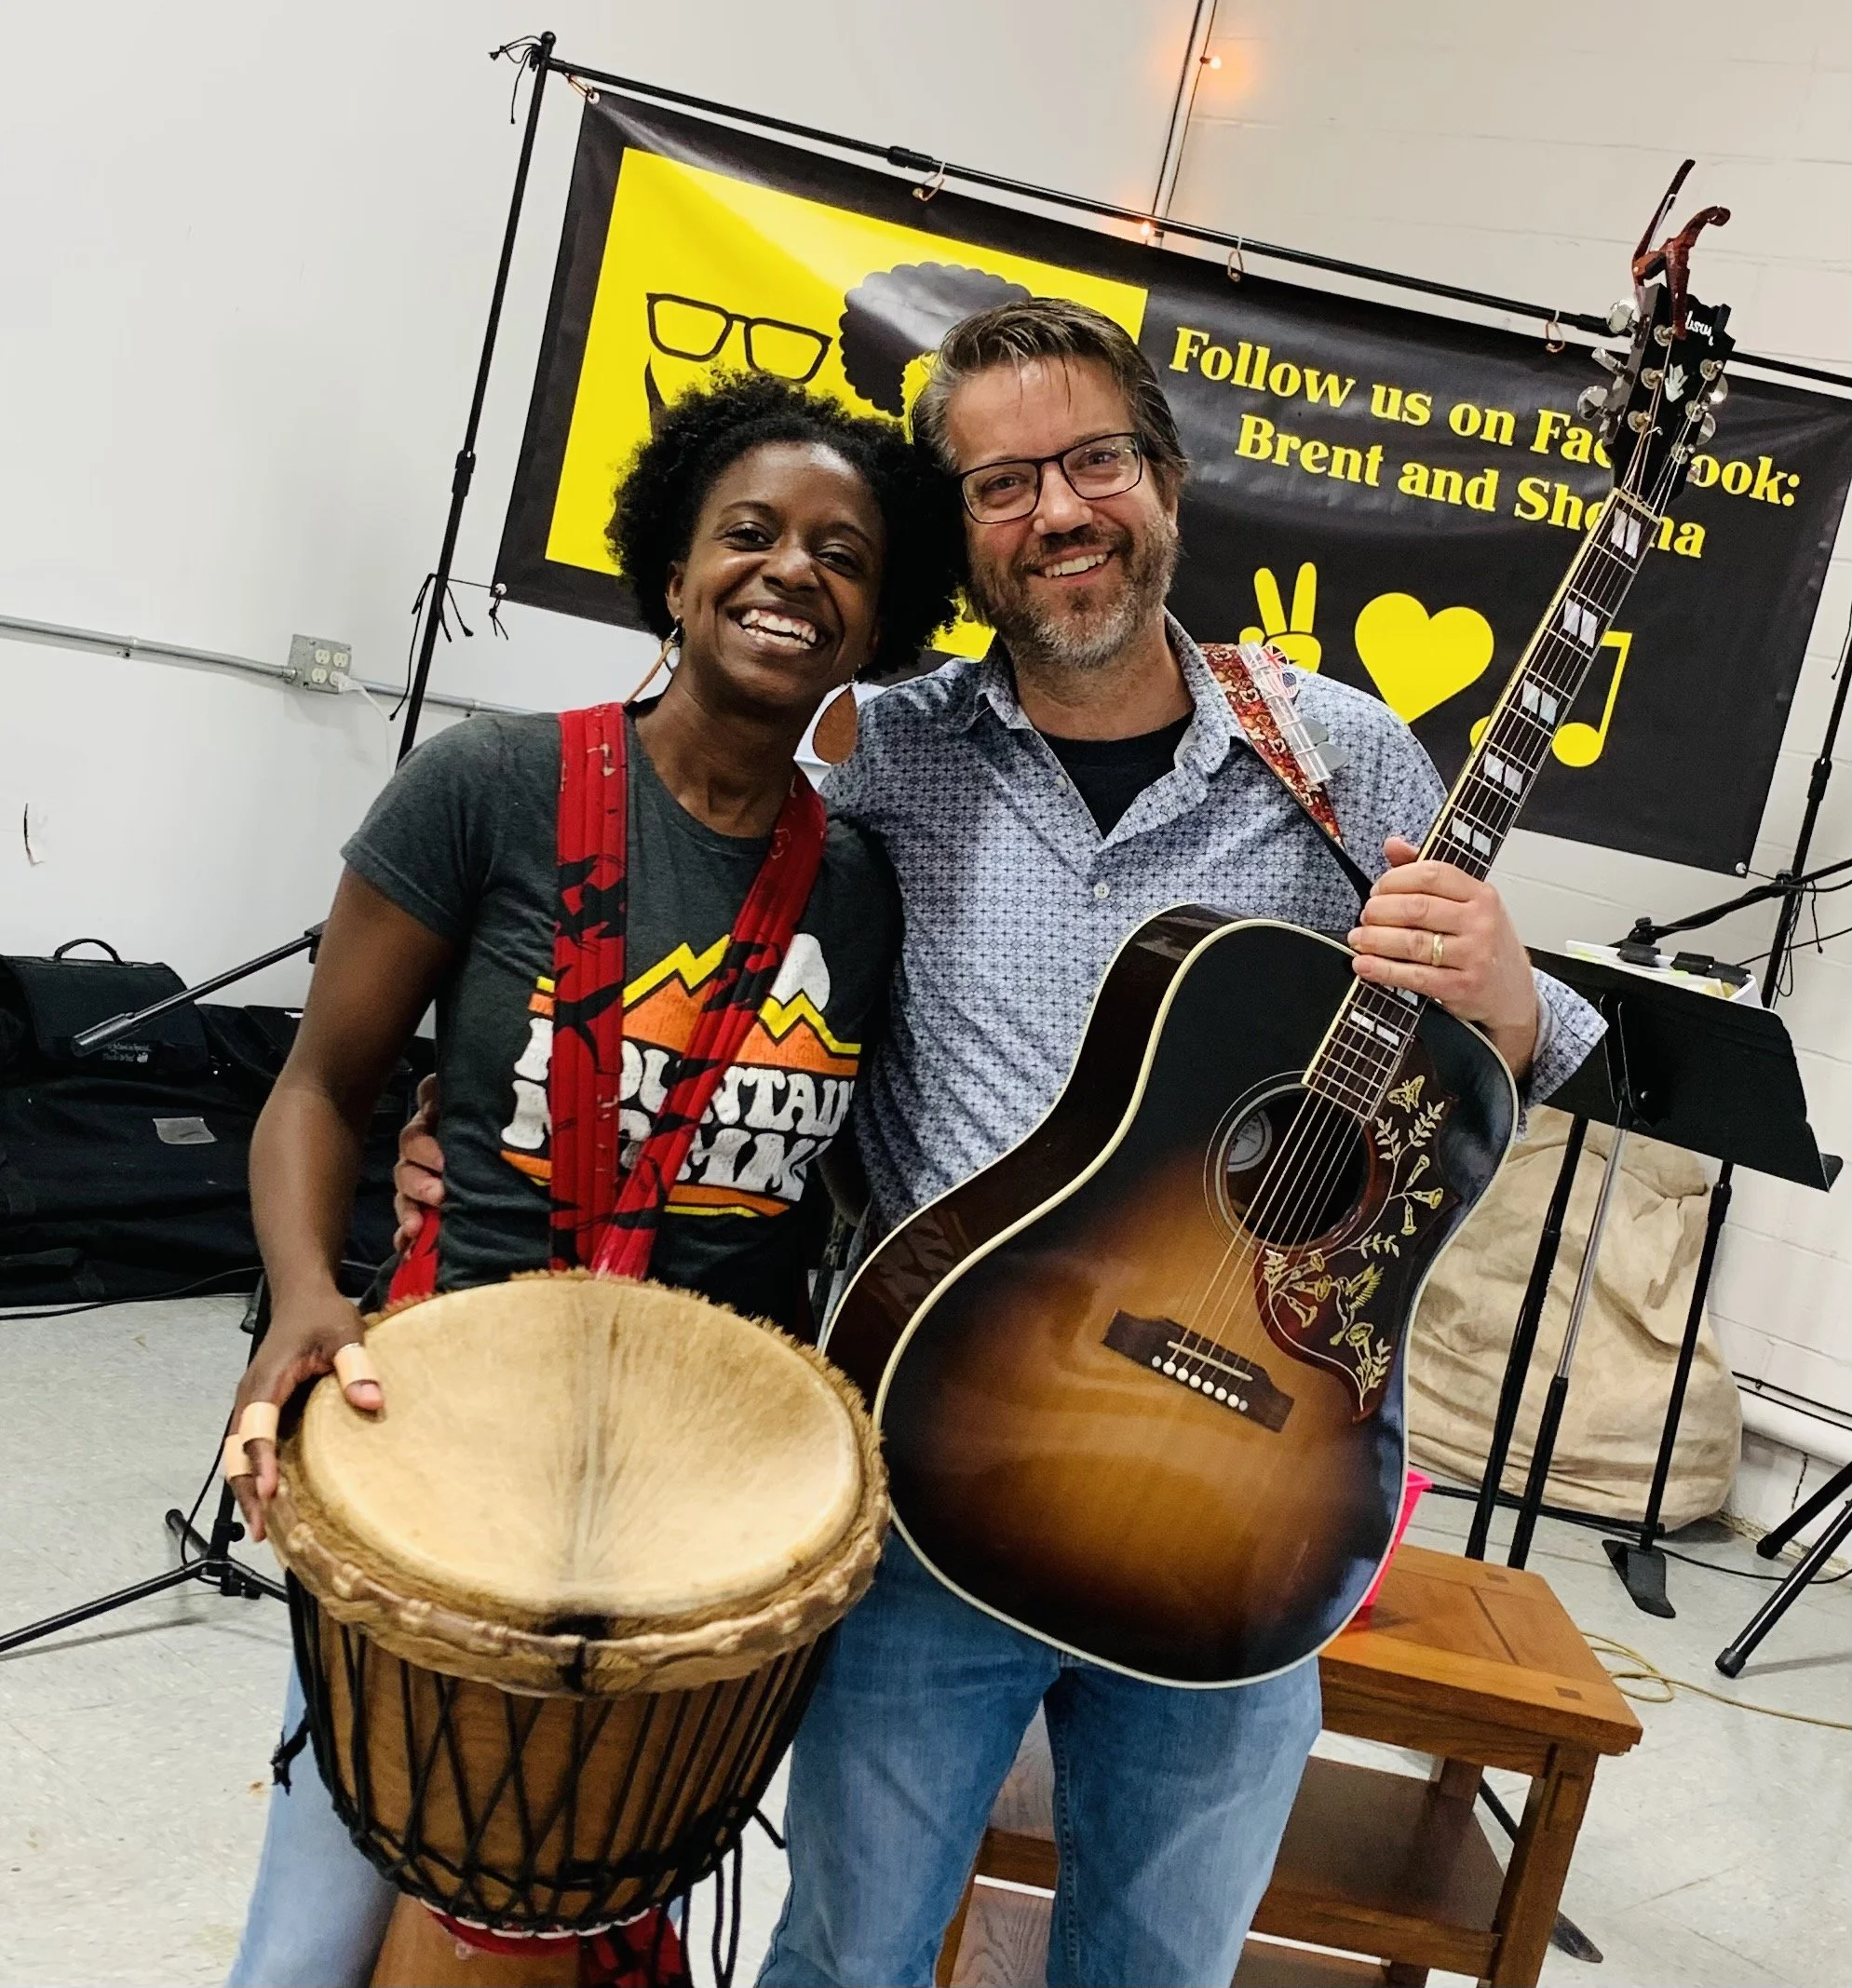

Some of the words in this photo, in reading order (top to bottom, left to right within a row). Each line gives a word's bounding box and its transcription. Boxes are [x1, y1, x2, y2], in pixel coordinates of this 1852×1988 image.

[1169, 326, 1357, 409] Follow
[1370, 383, 1433, 426] us
[1448, 401, 1517, 446] on
[1529, 408, 1801, 507] Facook:
[1234, 412, 1385, 487] Brent
[1397, 462, 1501, 512] and
[1513, 476, 1707, 559] Shna
